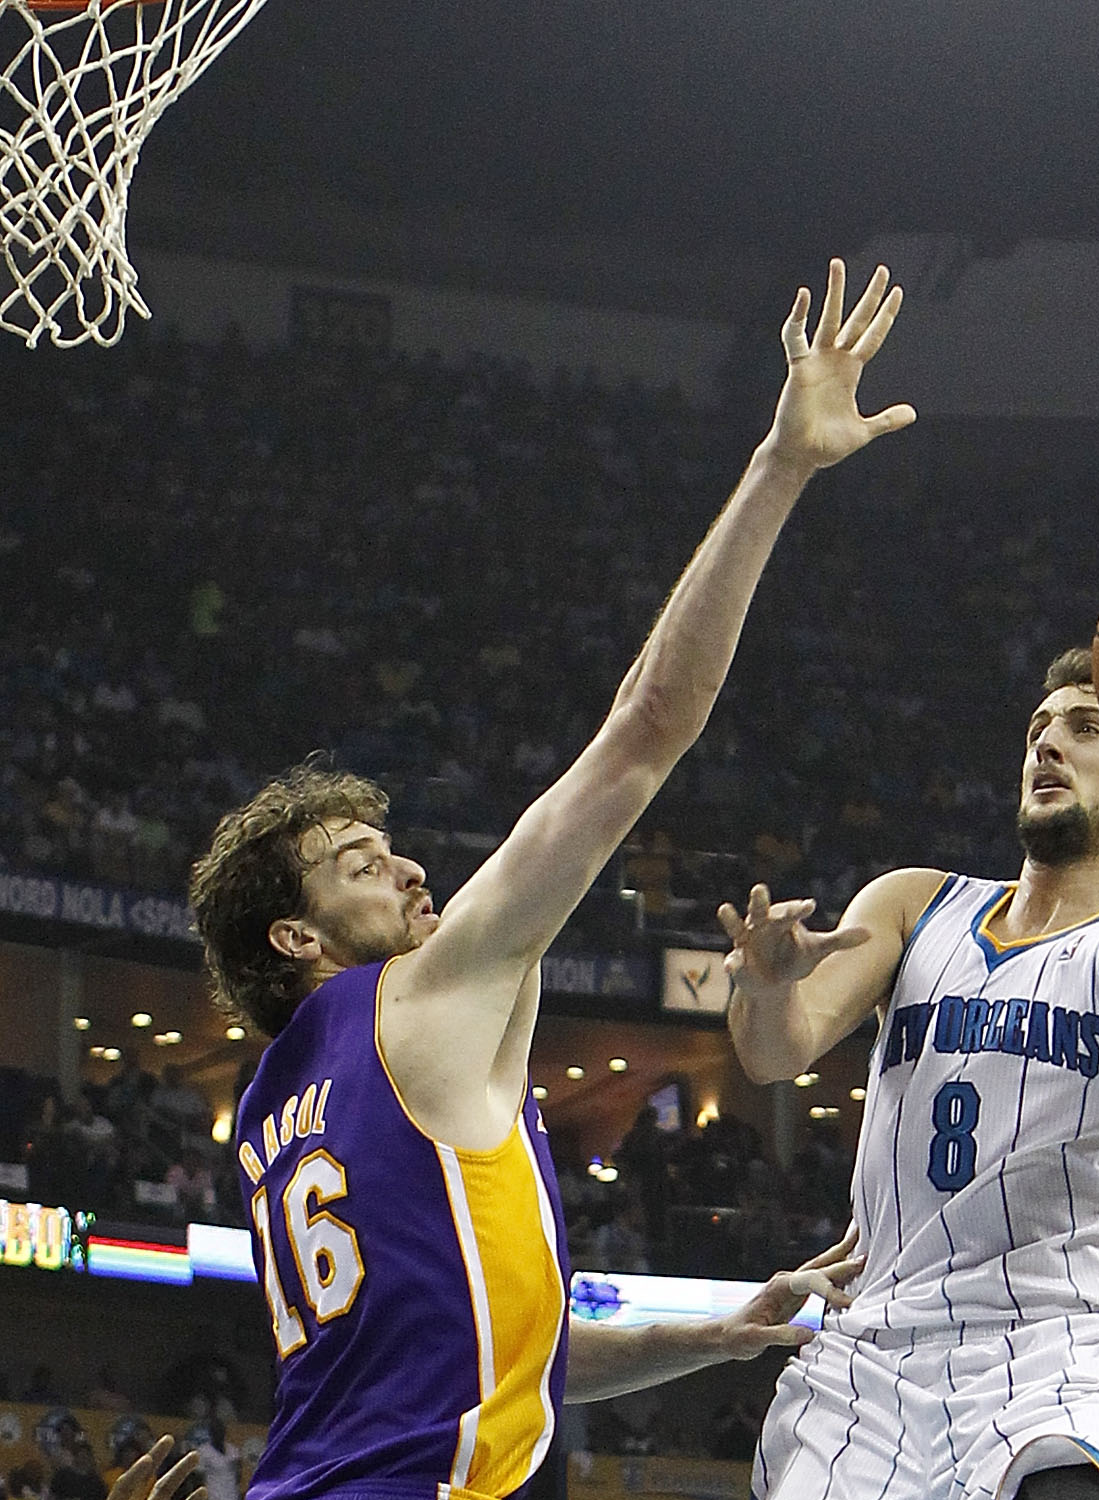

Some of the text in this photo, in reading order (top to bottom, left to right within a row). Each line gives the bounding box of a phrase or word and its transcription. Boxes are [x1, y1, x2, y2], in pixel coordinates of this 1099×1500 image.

[239, 1079, 332, 1185] GASOL
[927, 1081, 981, 1192] 8
[252, 1147, 365, 1361] 16
